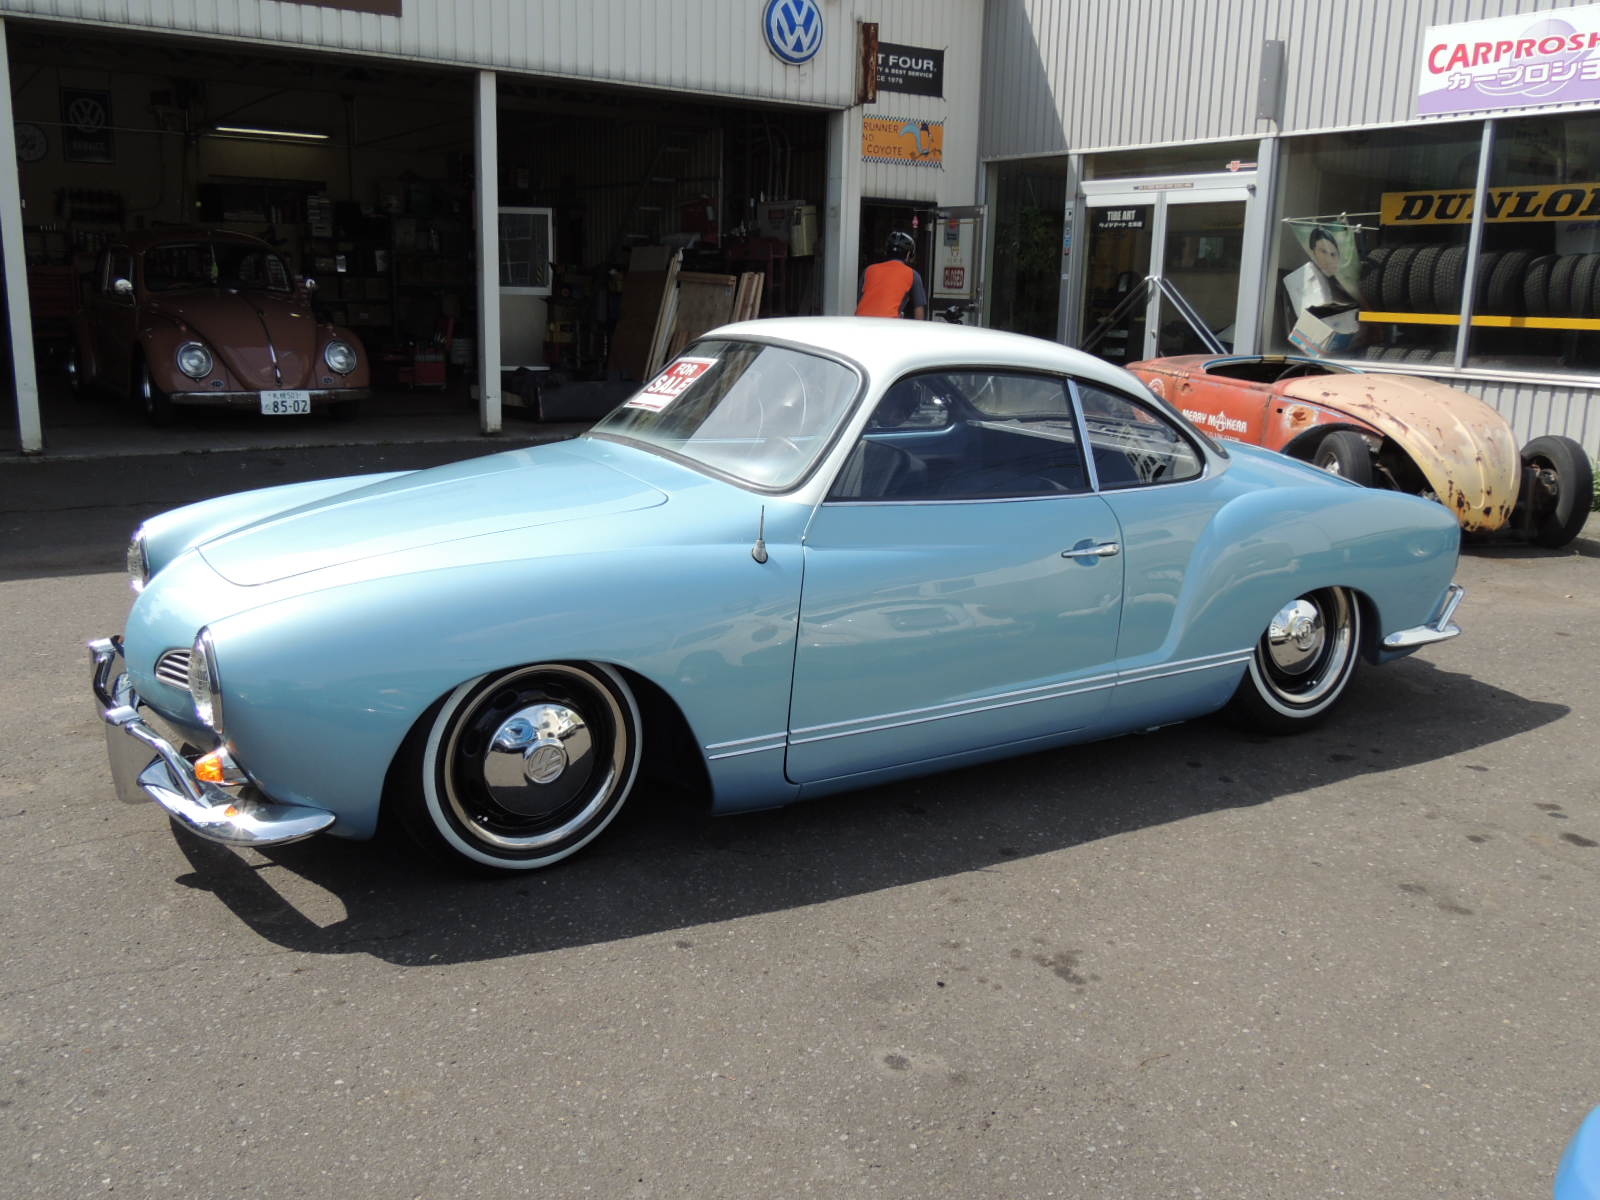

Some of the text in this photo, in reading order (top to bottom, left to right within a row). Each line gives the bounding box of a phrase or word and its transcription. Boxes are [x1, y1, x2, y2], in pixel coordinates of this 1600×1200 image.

[889, 55, 934, 71] FOUR
[908, 70, 933, 79] SERVICE
[864, 122, 899, 134] RUNNER
[867, 144, 903, 156] COYOTE
[673, 363, 698, 376] FOR
[647, 375, 695, 394] SALE
[273, 400, 308, 413] 85-02
[1182, 408, 1207, 424] MERRY
